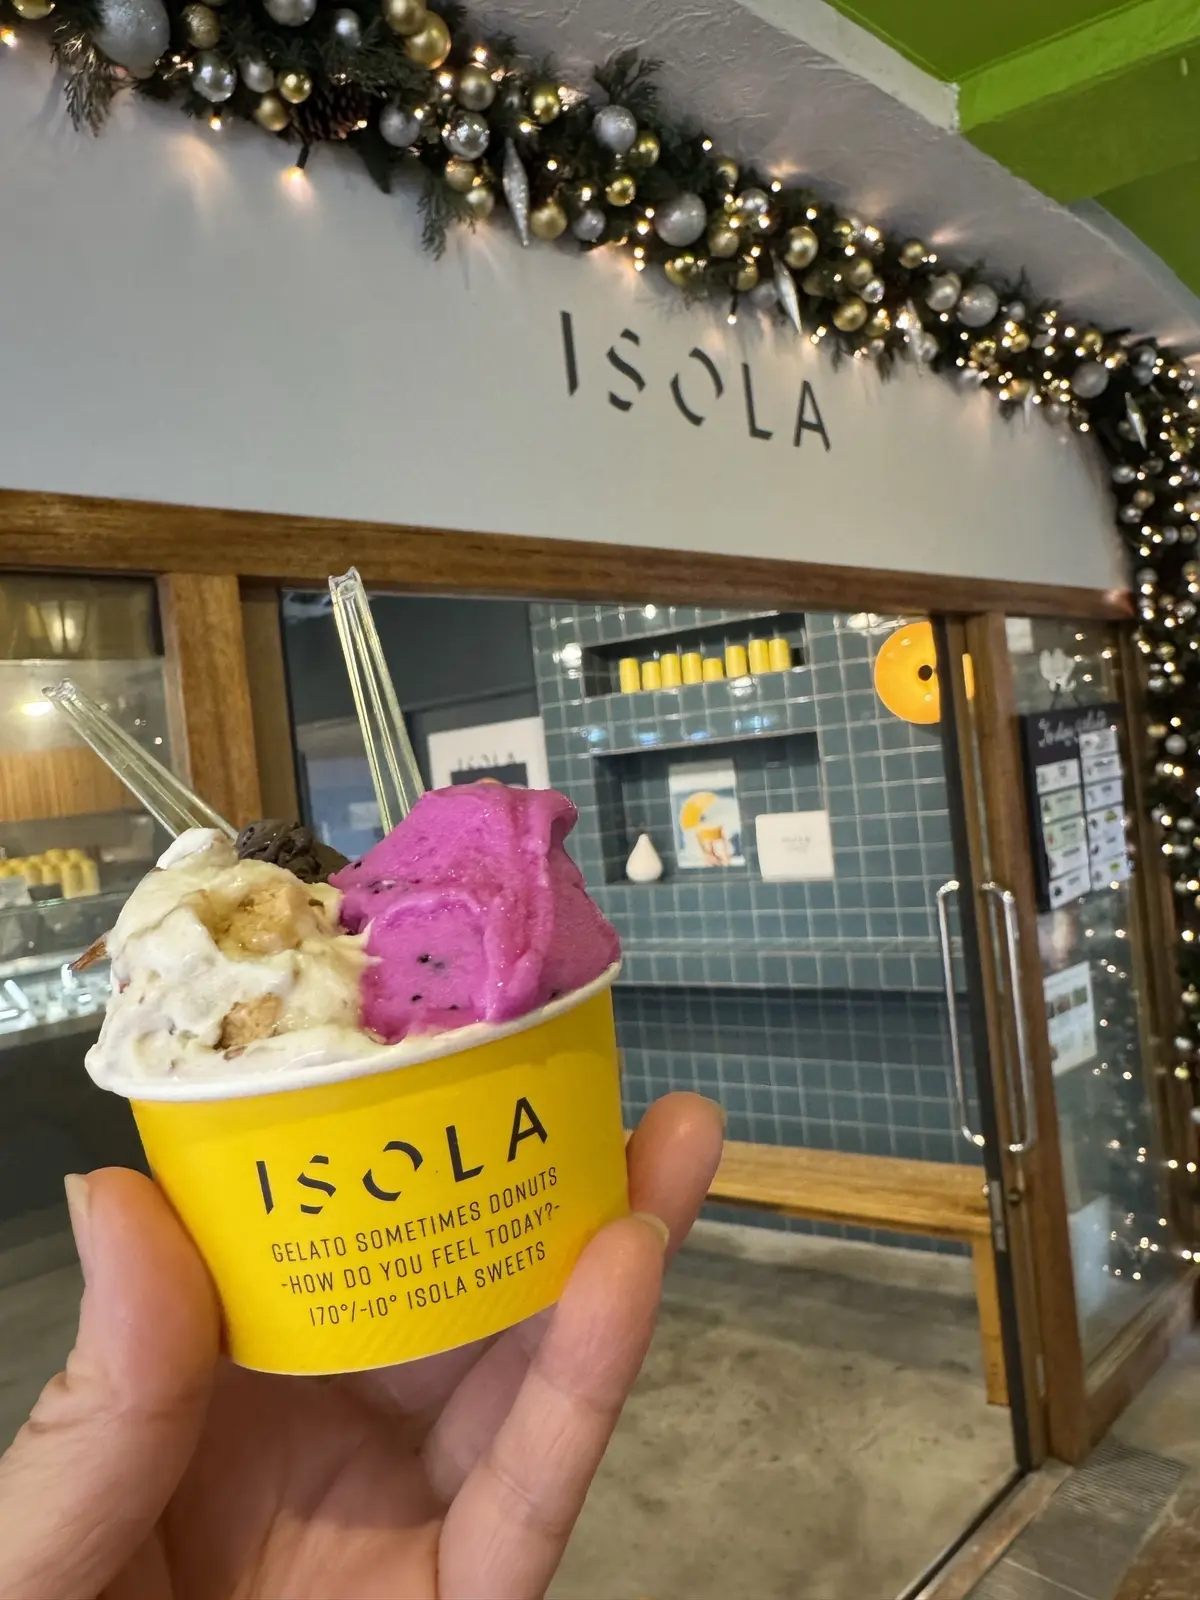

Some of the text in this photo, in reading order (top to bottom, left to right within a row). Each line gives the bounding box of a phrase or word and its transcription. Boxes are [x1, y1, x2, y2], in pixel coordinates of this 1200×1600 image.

[560, 310, 830, 451] ISOLA
[256, 1096, 548, 1215] ISOLA
[271, 1166, 558, 1263] GELATO SOMETIMES DONUTS
[343, 1266, 372, 1289] DO
[380, 1254, 424, 1282] YOU
[432, 1237, 481, 1268] FEEL
[407, 1276, 468, 1310] ISOLA
[475, 1241, 547, 1288] SWEETS
